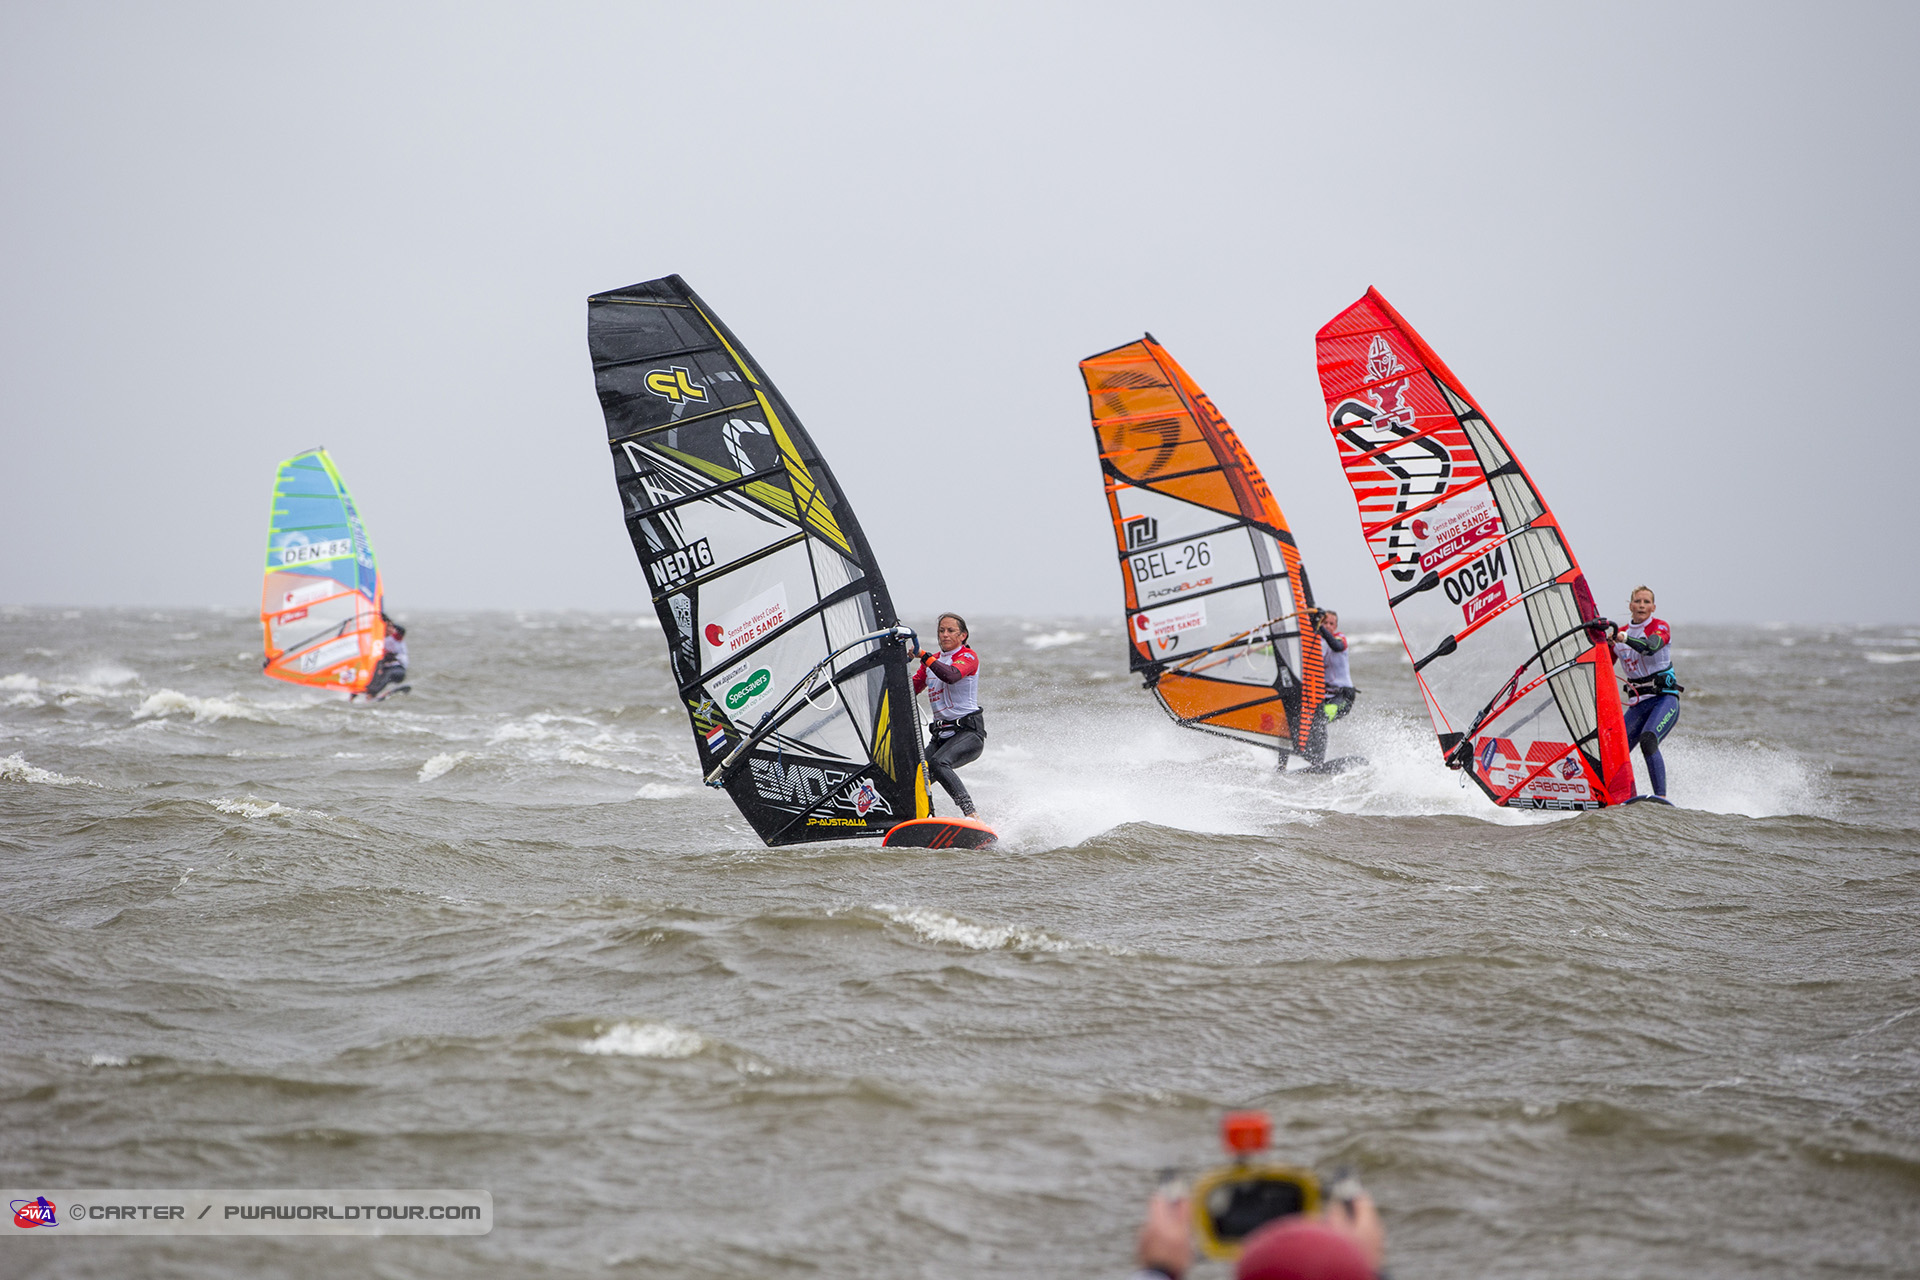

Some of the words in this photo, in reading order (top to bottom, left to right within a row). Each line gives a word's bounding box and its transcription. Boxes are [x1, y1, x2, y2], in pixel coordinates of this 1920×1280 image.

[1433, 523, 1448, 533] Sense
[1448, 517, 1457, 525] the
[1457, 509, 1470, 520] West
[1470, 502, 1485, 513] Coast
[1436, 526, 1462, 544] HVIDE
[1462, 510, 1490, 530] SANDE
[285, 540, 348, 563] DEN-85
[650, 541, 711, 587] NED16
[1134, 542, 1210, 582] BEL-26
[727, 626, 742, 639] Sense
[742, 620, 752, 630] the
[751, 612, 766, 624] West
[766, 603, 780, 616] Coast
[730, 629, 756, 651] HVIDE
[756, 612, 784, 635] SANDE
[1154, 624, 1175, 636] HVIDE
[1177, 618, 1201, 630] SANDE
[729, 674, 767, 704] Specsavers
[1508, 798, 1599, 811] SEVERNE
